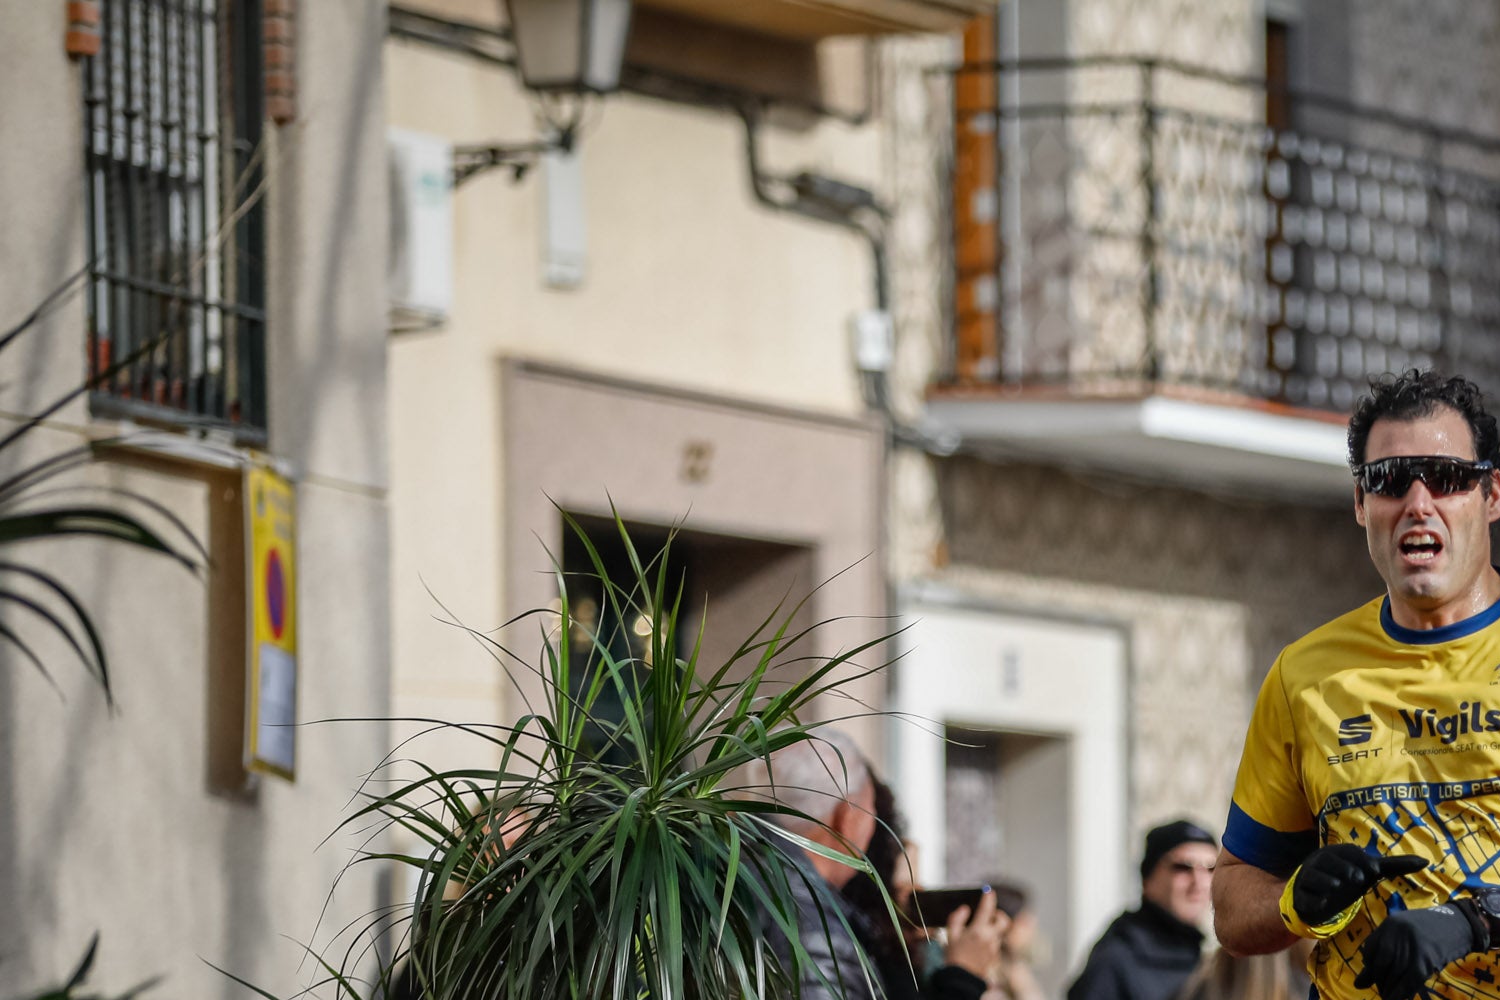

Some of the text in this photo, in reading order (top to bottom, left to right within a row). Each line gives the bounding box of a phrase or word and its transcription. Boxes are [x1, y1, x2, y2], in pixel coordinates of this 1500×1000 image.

[1327, 747, 1383, 766] SEAT
[1455, 742, 1475, 753] SEAT
[1476, 742, 1488, 750] en
[1346, 784, 1430, 806] ATLETISMO
[1439, 784, 1463, 798] LOS
